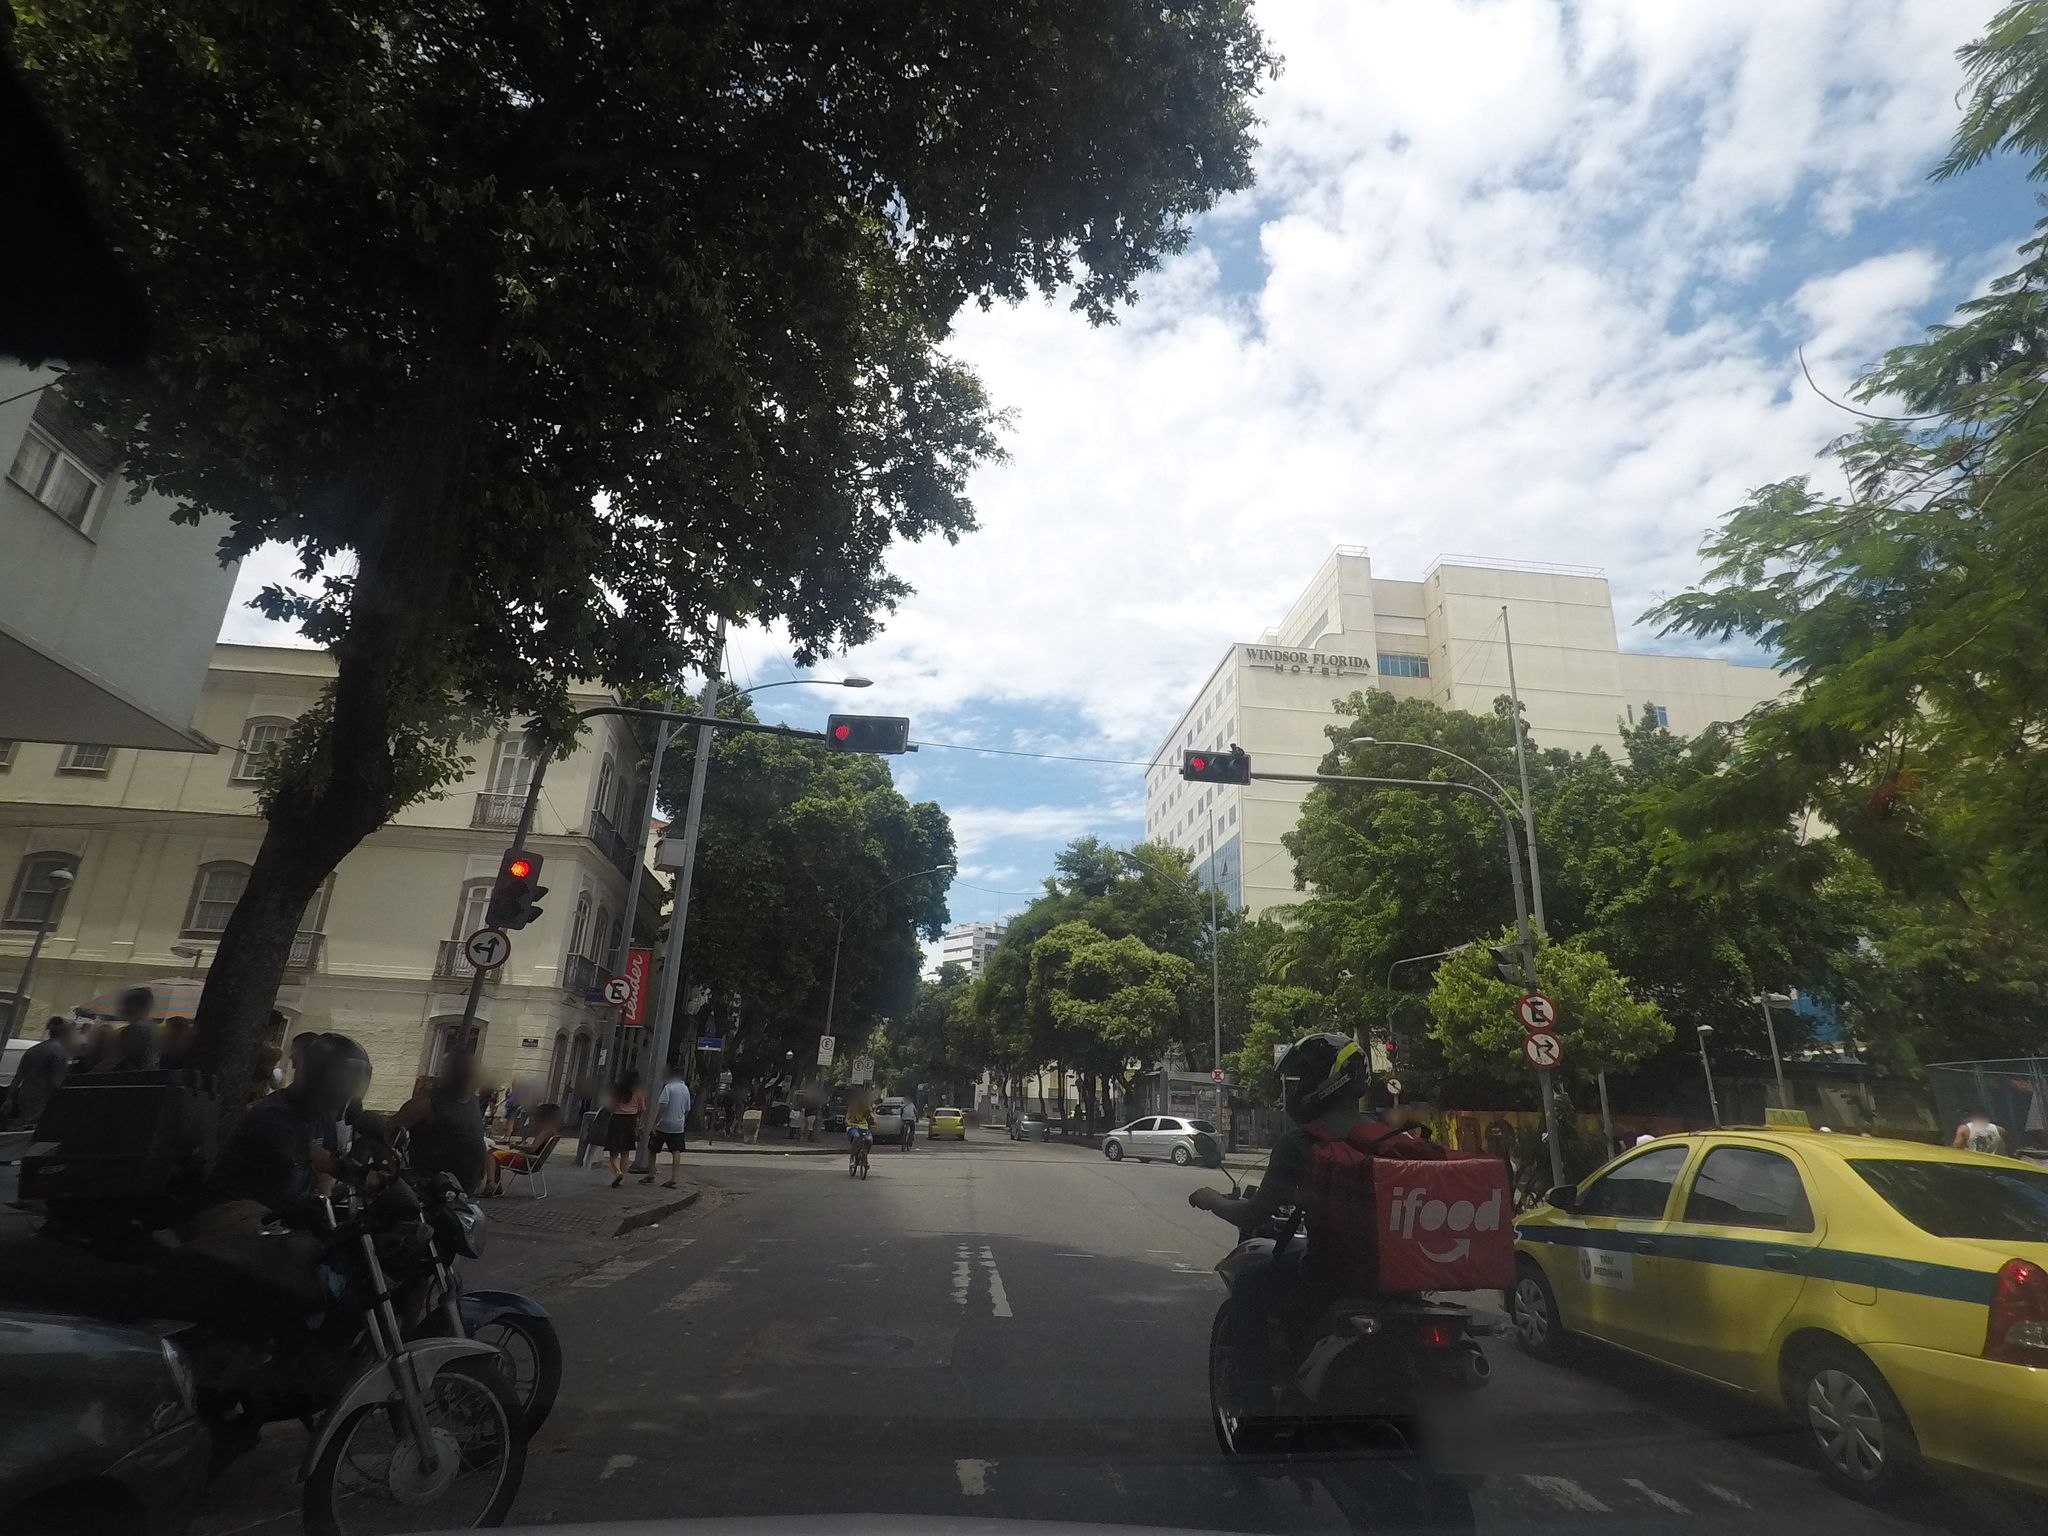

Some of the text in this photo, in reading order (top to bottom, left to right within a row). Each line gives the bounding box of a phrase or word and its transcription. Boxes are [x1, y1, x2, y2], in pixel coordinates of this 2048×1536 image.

[1246, 647, 1371, 669] WINDSOR FLORIDA
[1275, 663, 1344, 677] HOTEL
[1530, 1001, 1546, 1022] E
[1768, 1110, 1807, 1126] TAXI
[1389, 1186, 1501, 1240] ifood
